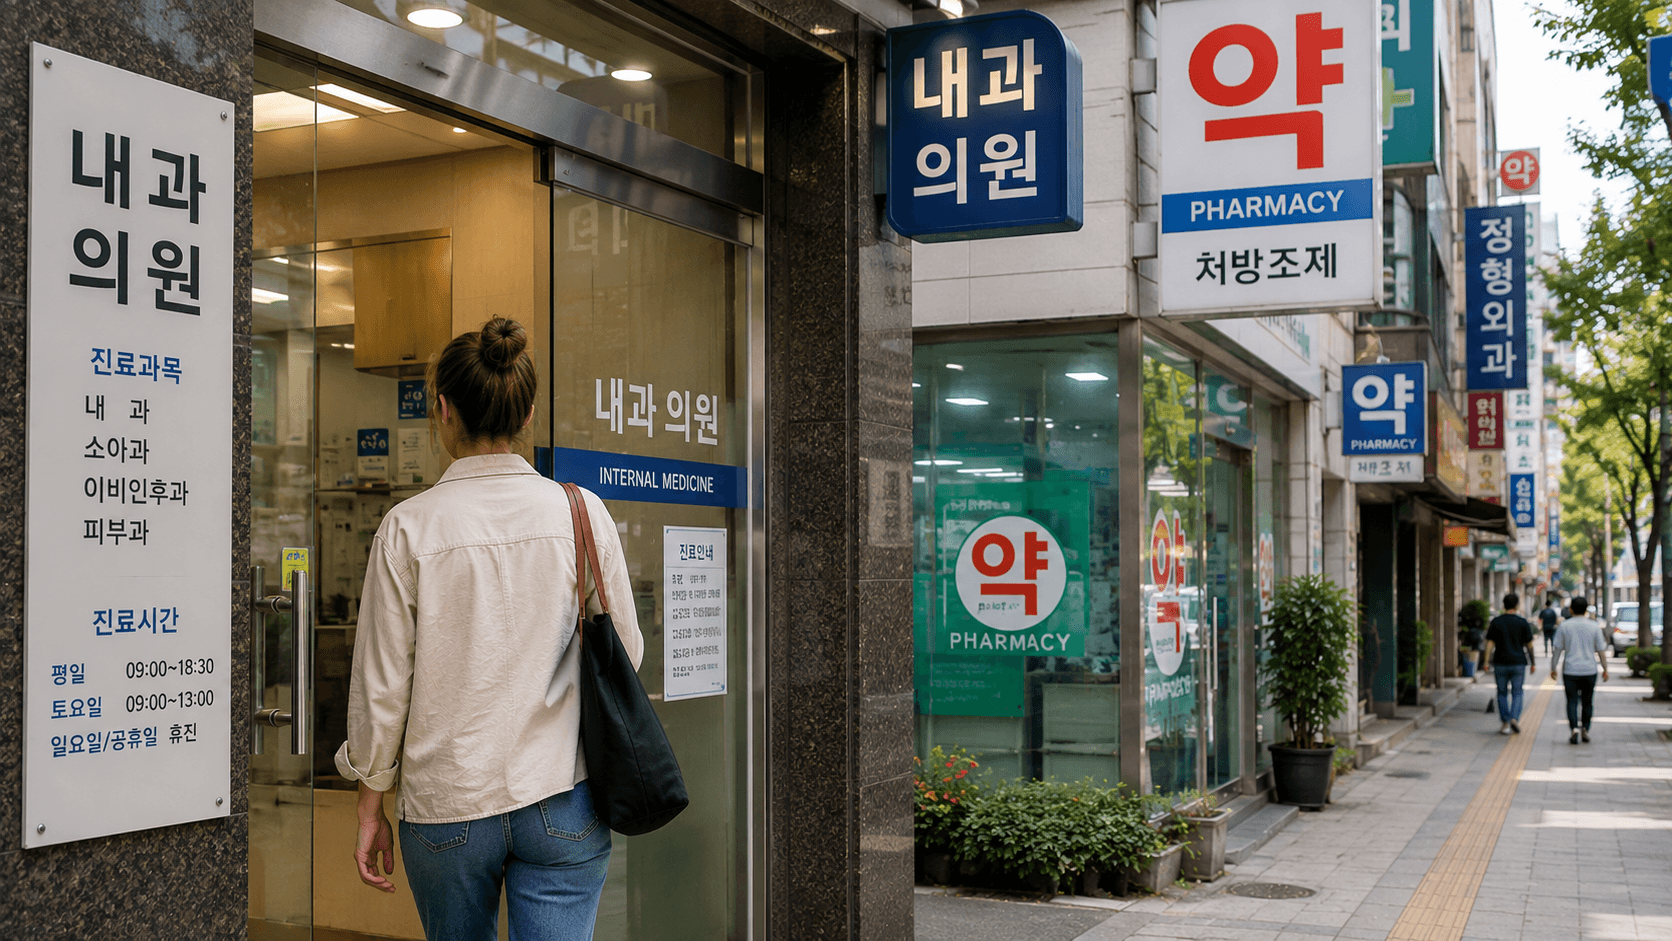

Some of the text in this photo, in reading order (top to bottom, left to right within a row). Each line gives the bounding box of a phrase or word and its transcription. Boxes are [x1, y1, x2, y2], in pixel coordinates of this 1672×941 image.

[914, 39, 1042, 118] 내과
[1189, 12, 1343, 169] 약
[71, 129, 206, 224] 내과
[914, 130, 1037, 204] 의원
[1504, 155, 1535, 185] 약
[1190, 190, 1344, 222] PHARMACY
[70, 227, 201, 316] 의원
[1196, 243, 1337, 286] 처방조제
[1481, 217, 1517, 379] 정형외과
[91, 348, 182, 384] 진료과목
[595, 378, 718, 445] 내과 의원
[1353, 374, 1415, 435] 약
[84, 436, 150, 465] 소아과
[1351, 438, 1417, 450] PHARMACY
[84, 476, 189, 506] 이비인후과
[600, 466, 714, 493] INTERNAL MEDICINE
[84, 518, 149, 545] 피부과
[972, 532, 1048, 615] 약
[92, 607, 180, 637] 진료시간
[950, 631, 1071, 652] PHARMACY
[51, 658, 214, 685] 평일 09:00~18:30
[51, 690, 214, 719] 토요일 09:00~13:00
[51, 723, 197, 757] 일요일/공휴일 휴진
